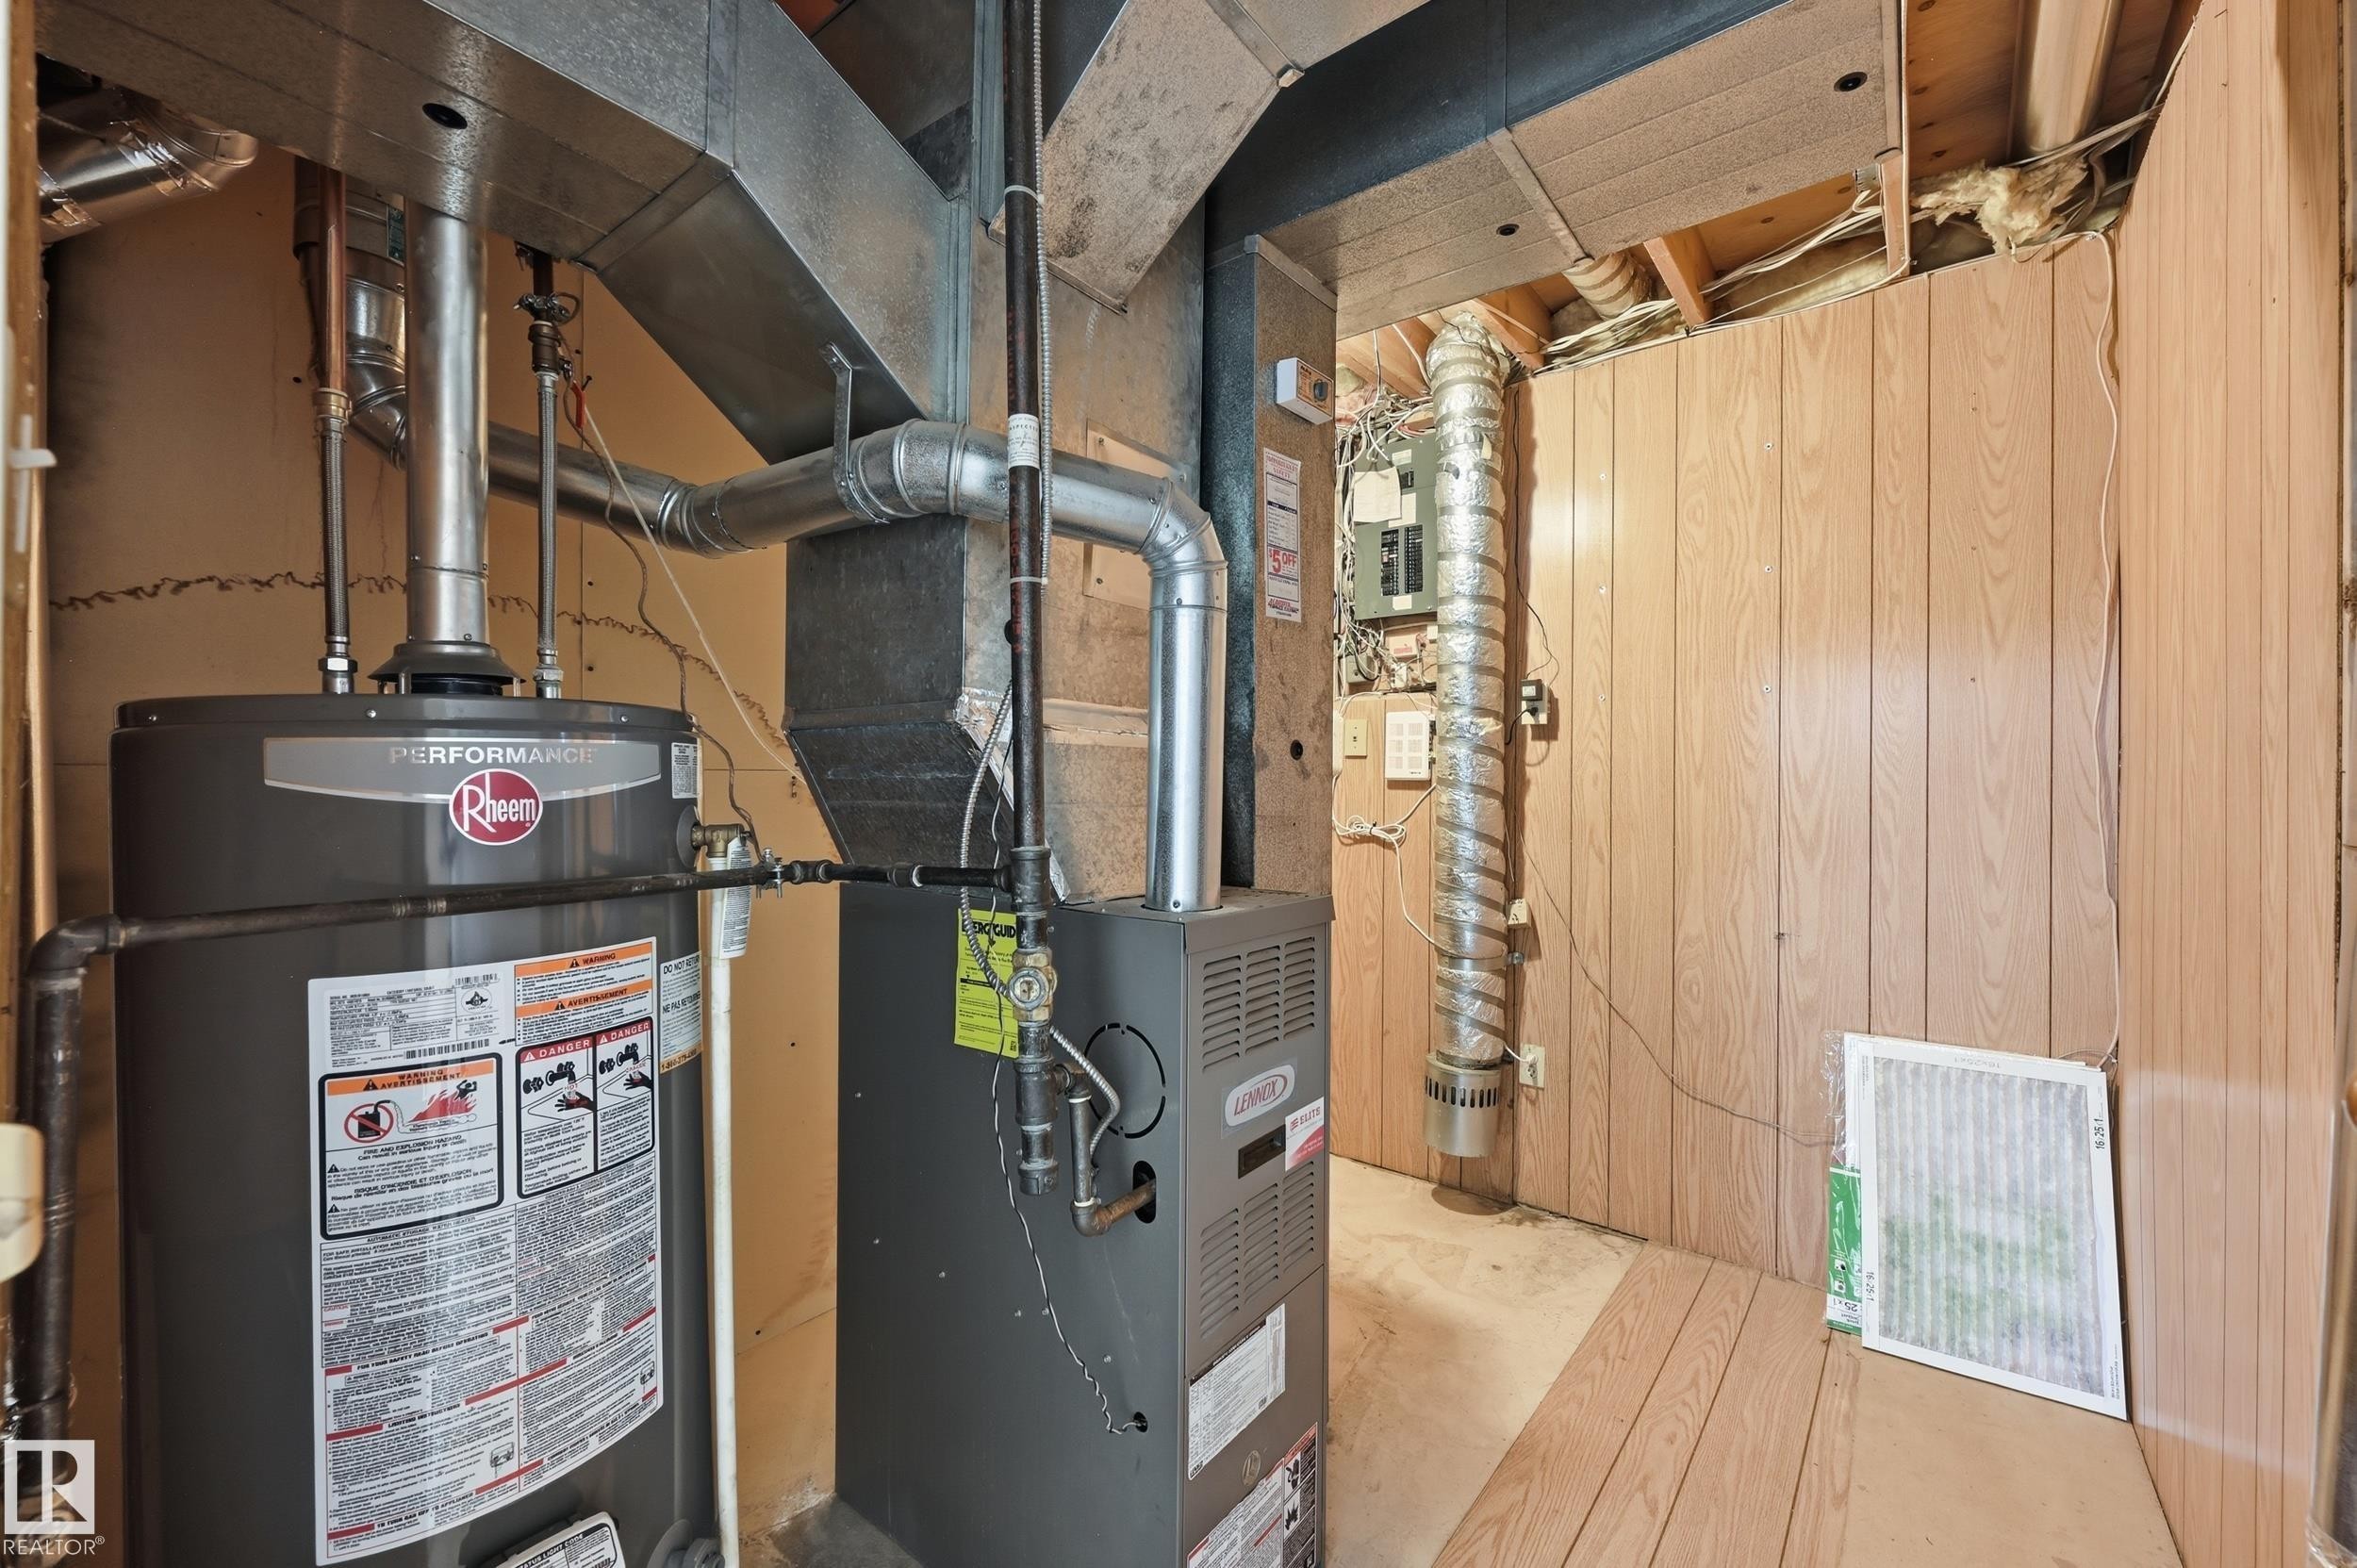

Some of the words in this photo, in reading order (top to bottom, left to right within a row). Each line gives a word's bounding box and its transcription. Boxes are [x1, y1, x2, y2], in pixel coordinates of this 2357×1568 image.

[1282, 552, 1297, 568] OFF
[389, 746, 594, 764] PERFORMANCE
[462, 772, 536, 833] Rheem
[583, 952, 616, 965] WARNING
[663, 964, 673, 975] DO
[674, 960, 685, 971] NOT
[568, 988, 628, 1007] AVERTISSEMENT
[611, 1020, 651, 1040] DANGER
[539, 1040, 590, 1057] DANGER
[382, 1072, 461, 1089] AVERTISSEMENT
[398, 1069, 444, 1081] WARNING
[1234, 1079, 1278, 1116] LENNOX
[542, 1544, 563, 1560] LIGHT
[564, 1533, 584, 1546] CODE
